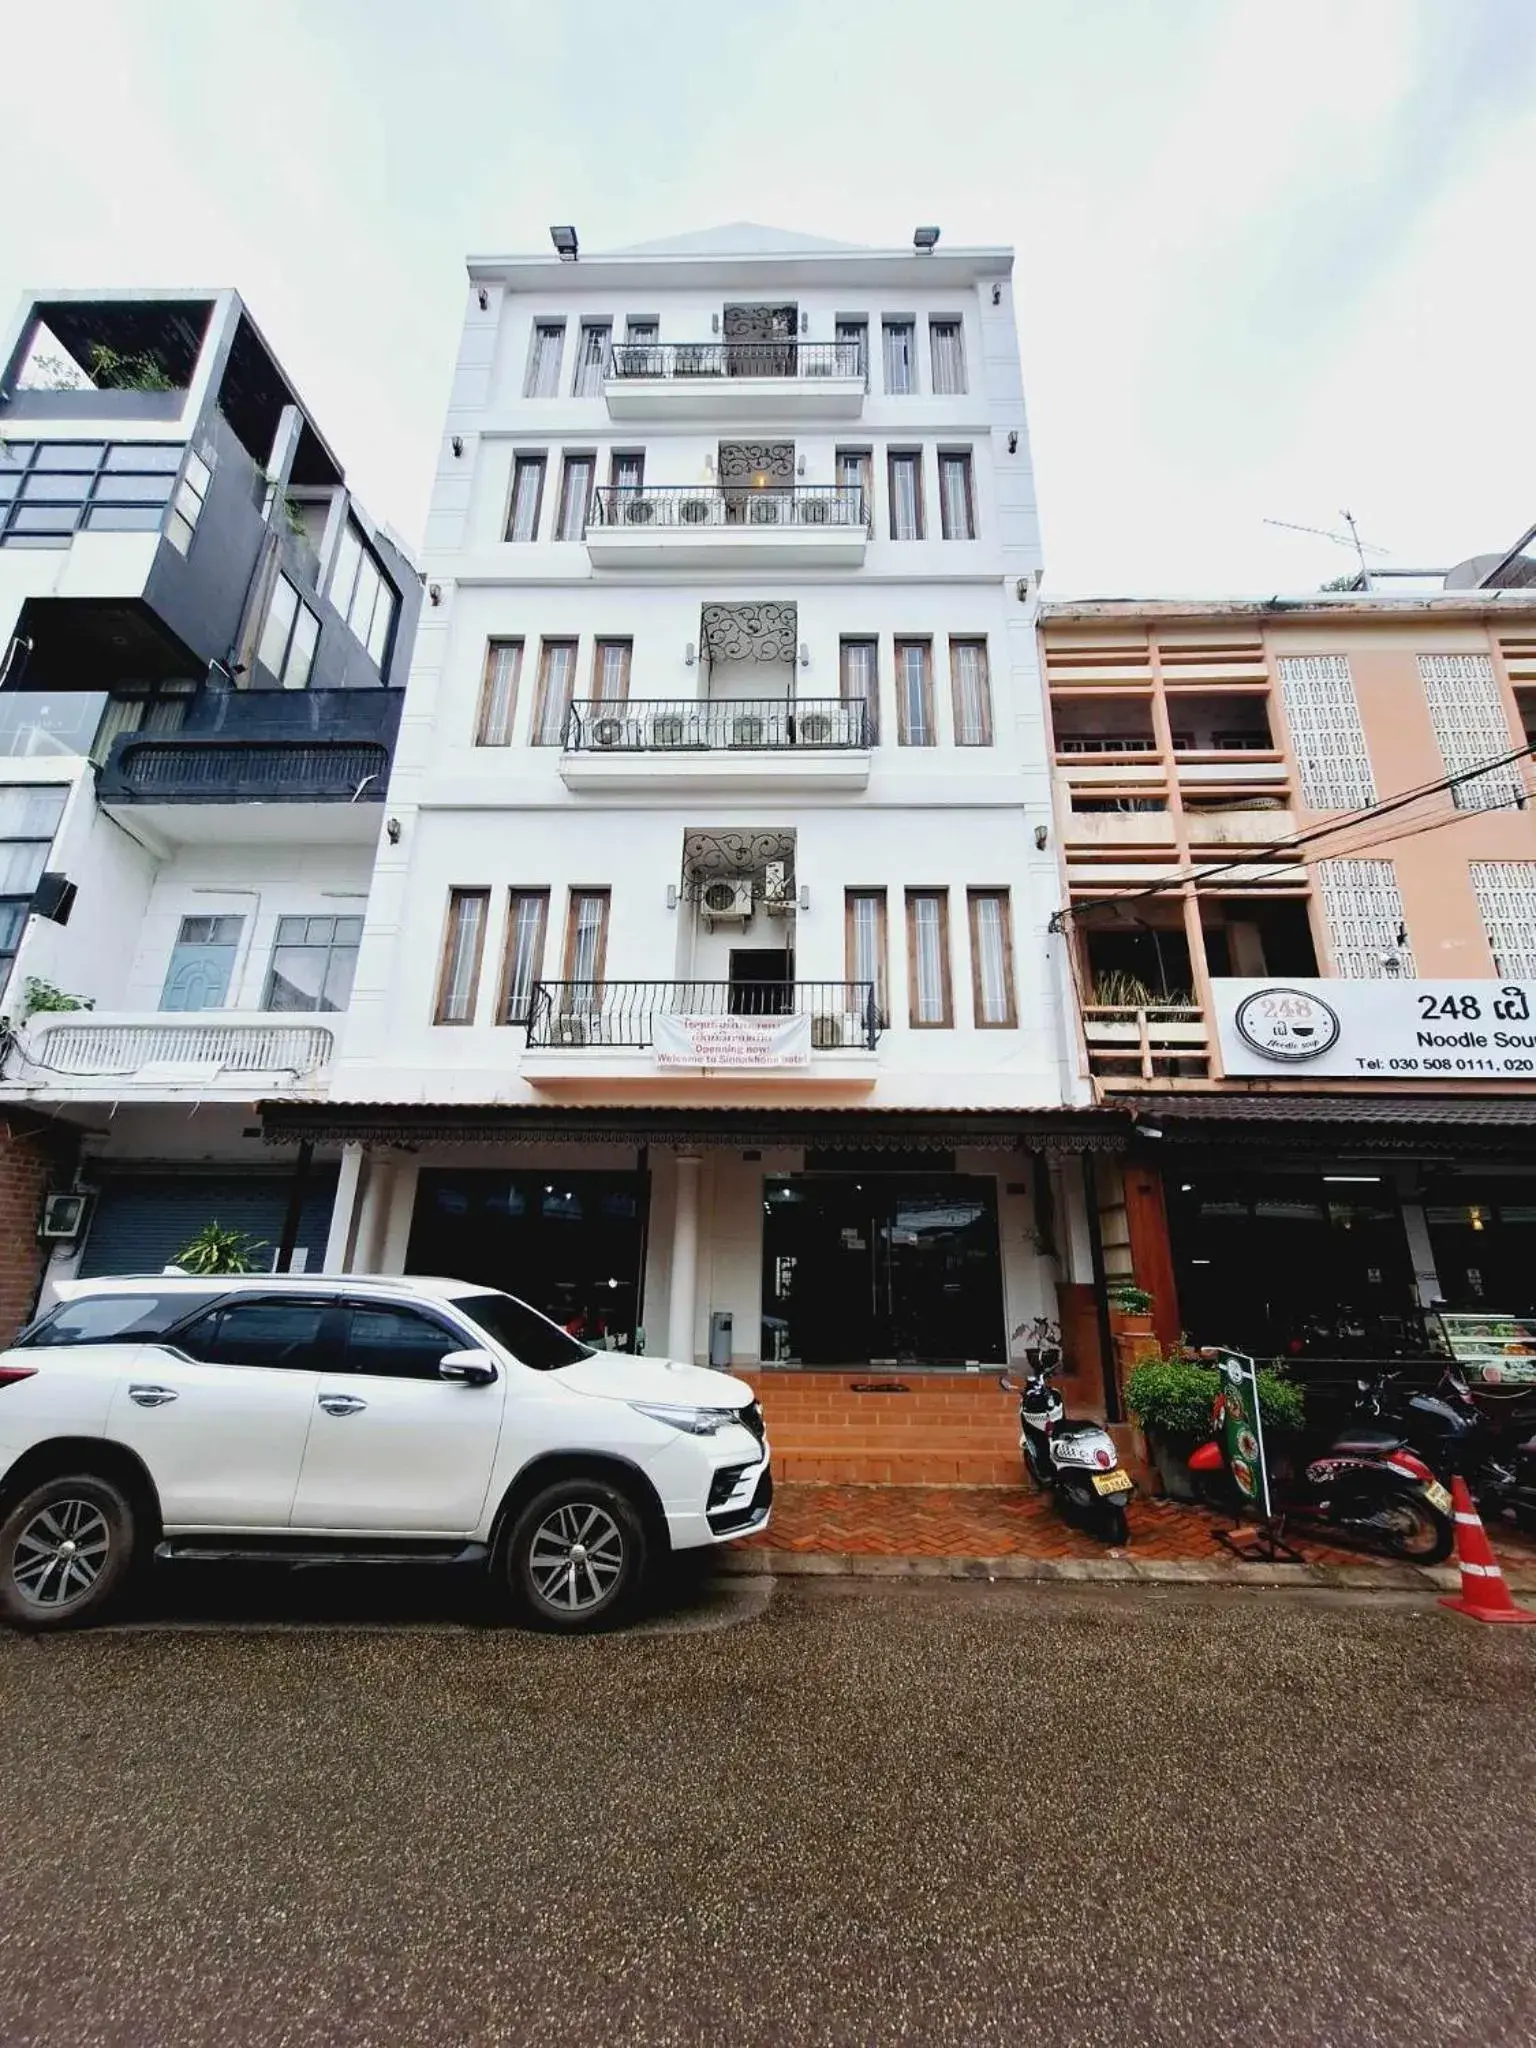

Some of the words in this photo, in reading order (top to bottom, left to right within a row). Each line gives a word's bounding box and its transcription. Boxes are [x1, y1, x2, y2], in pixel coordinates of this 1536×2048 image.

[1260, 998, 1313, 1018] 248
[1417, 995, 1482, 1020] 248
[1416, 1031, 1488, 1048] Noodle
[1494, 1032, 1536, 1048] Sou
[657, 1054, 703, 1063] Welcome
[706, 1055, 716, 1063] to
[1356, 1057, 1384, 1070] Tel:
[1389, 1058, 1418, 1070] 030
[1423, 1058, 1452, 1070] 508
[1504, 1059, 1534, 1071] 020
